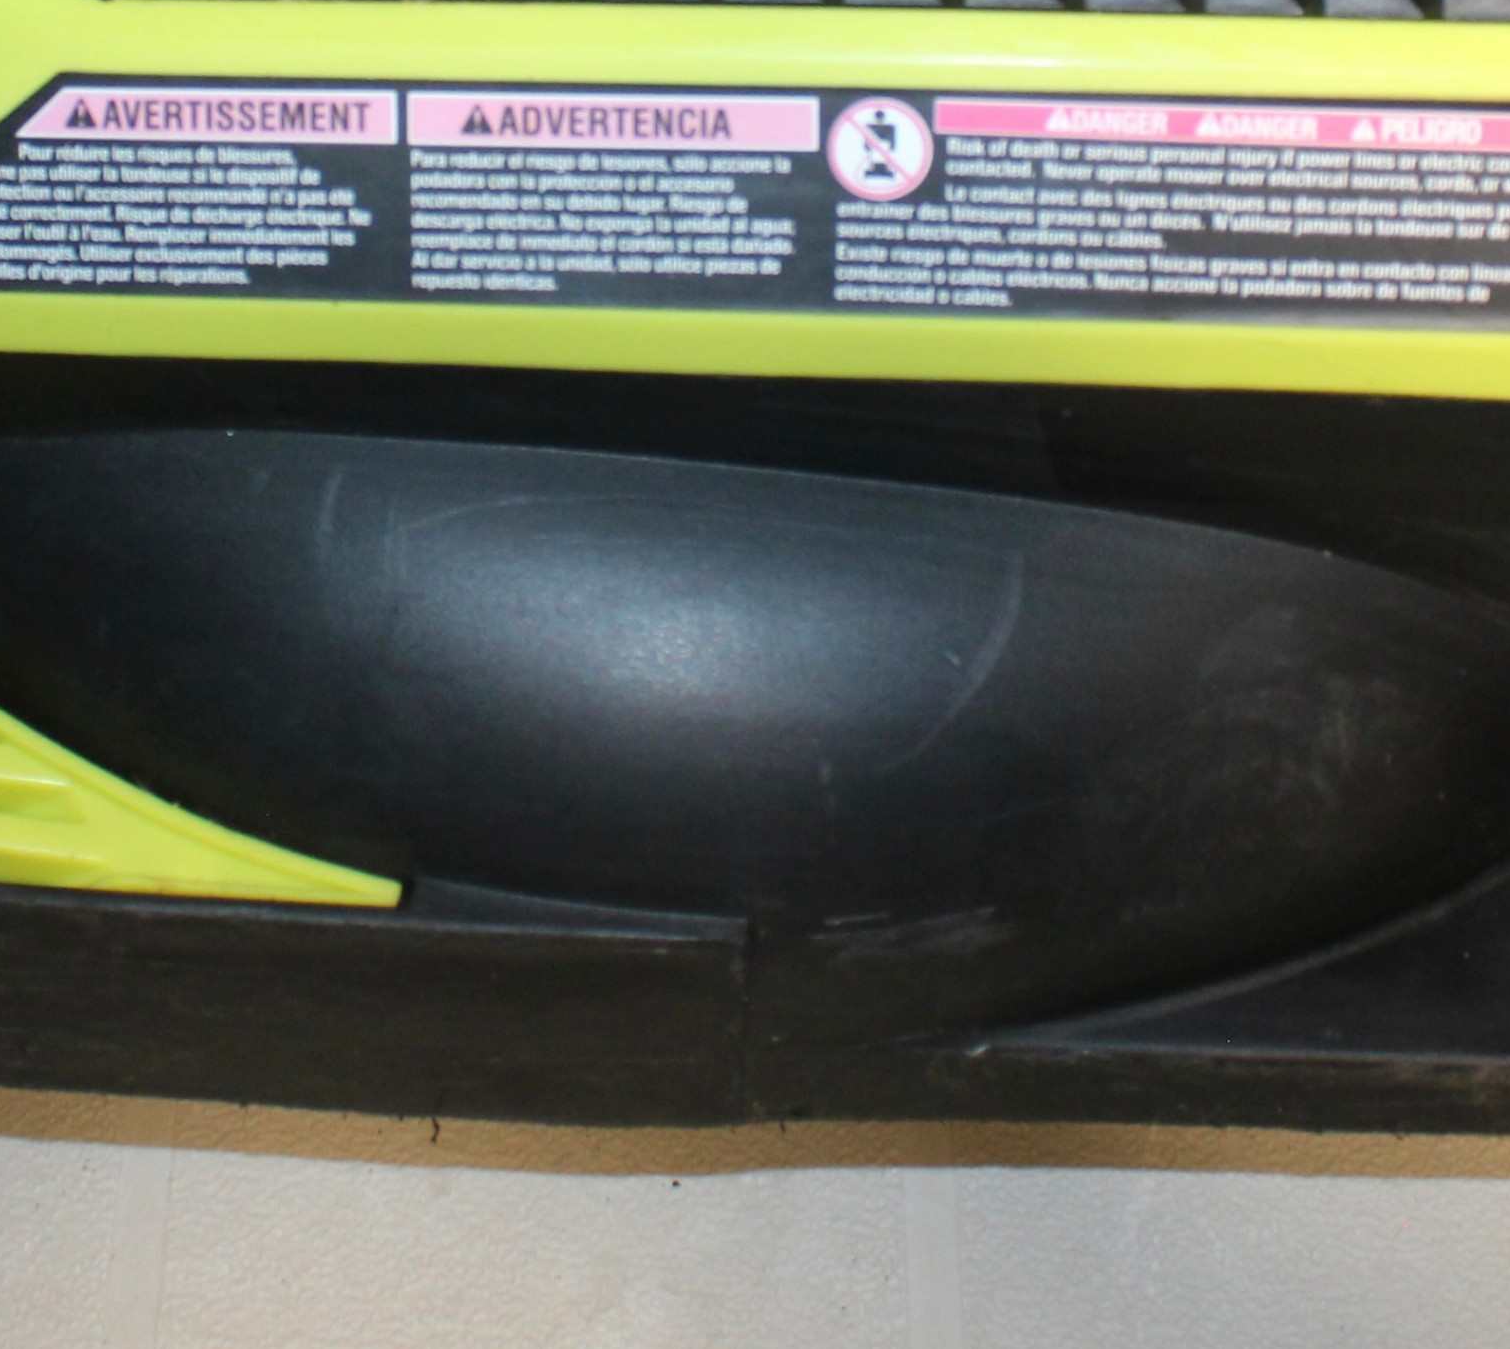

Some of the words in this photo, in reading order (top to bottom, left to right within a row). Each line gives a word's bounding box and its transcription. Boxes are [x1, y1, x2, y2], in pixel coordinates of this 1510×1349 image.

[102, 99, 371, 133] AVERTISSEMENT
[498, 105, 732, 138] ADVERTENCIA
[1068, 110, 1170, 135] DANGER
[1219, 113, 1320, 140] DANGER
[1381, 118, 1483, 145] PELIGRO
[945, 139, 987, 156] Risk
[987, 140, 1007, 157] of
[1008, 141, 1059, 159] death
[1060, 144, 1080, 159] or
[1083, 143, 1148, 161] serious
[1148, 145, 1225, 166] personal
[1226, 147, 1278, 167] injury
[1278, 149, 1295, 166] if
[1294, 152, 1350, 170] power
[1351, 151, 1396, 169] lines
[1396, 155, 1416, 170] or
[1417, 153, 1485, 172] electric
[1042, 162, 1092, 180] Never
[1094, 164, 1162, 184] operate
[1163, 168, 1223, 184] mower
[1225, 170, 1265, 185] over
[1266, 169, 1349, 188] electrical
[1478, 177, 1499, 192] or
